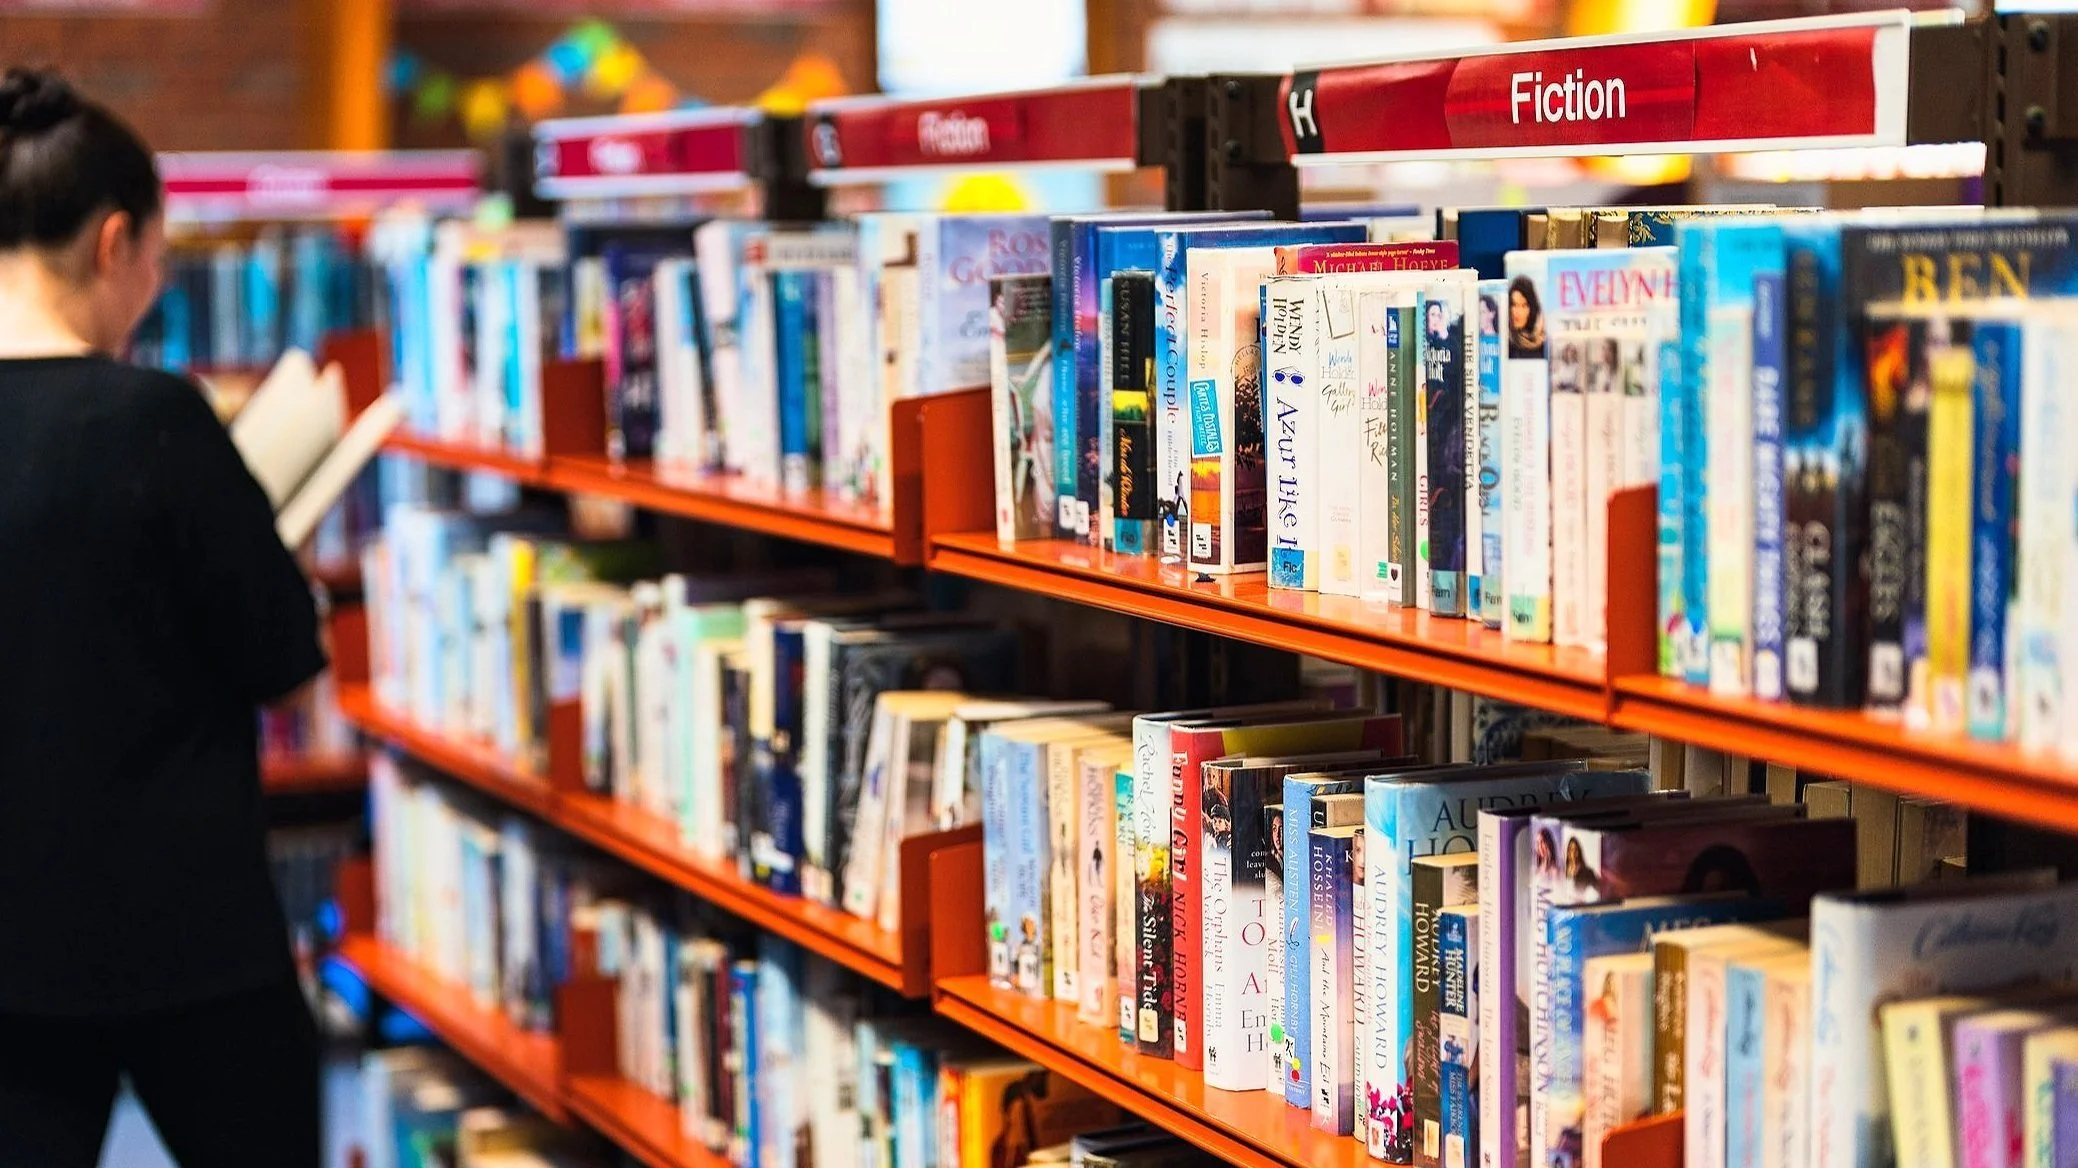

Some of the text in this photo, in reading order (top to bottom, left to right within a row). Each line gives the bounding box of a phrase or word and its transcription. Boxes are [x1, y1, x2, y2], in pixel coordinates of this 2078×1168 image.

[1289, 89, 1318, 138] H
[1510, 68, 1626, 125] Fiction
[949, 257, 1048, 285] GOOD
[989, 228, 1048, 255] ROS
[1393, 257, 1448, 270] HOEYE
[1165, 267, 1178, 344] Perfect
[1560, 269, 1657, 308] EVELYN
[1902, 251, 2032, 304] BEN
[1120, 280, 1130, 381] SUSAN HILL
[1199, 272, 1209, 370] Victoria Hislop
[1273, 297, 1288, 354] HOLDEN
[1289, 298, 1304, 356] WENDY
[1162, 349, 1180, 423] Couple
[1361, 396, 1387, 410] Hold
[1389, 351, 1397, 396] ANNE
[1193, 381, 1220, 452] CARTES POSTALES
[1276, 397, 1298, 469] Azur
[1389, 408, 1397, 481] HOLMAN
[1465, 331, 1474, 490] THE SILK VENDETTA
[1277, 475, 1300, 528] Like
[1419, 475, 1428, 526] GIRLS
[1284, 562, 1297, 573] Fic
[1138, 741, 1156, 845] Rachel Hore
[1172, 750, 1189, 882] Funny Girl
[1246, 860, 1266, 869] leavi
[1289, 808, 1299, 912] MISS AUSTEN
[1313, 845, 1324, 930] HOSSEINI
[1325, 853, 1333, 927] KHALED
[1482, 833, 1493, 891] Lindsey
[1204, 867, 1214, 959] of Ardwick
[1212, 857, 1228, 973] The Orphans
[1537, 885, 1553, 934] MEG
[1142, 893, 1158, 1010] The Silent Tide
[1174, 890, 1188, 1021] NICK HORNB
[1267, 937, 1279, 974] Moll
[1354, 914, 1365, 1025] HOWARD
[1375, 865, 1387, 1070] AUDREY HOWARD
[1415, 902, 1430, 993] HOWARD
[1431, 908, 1441, 988] AUDREY
[1445, 948, 1457, 1008] HUNTER
[1455, 947, 1465, 1014] MADELINE
[1215, 983, 1225, 1028] Emma
[1271, 998, 1279, 1022] Hor
[1289, 955, 1299, 1034] GILL HORNBY
[1320, 948, 1330, 1059] And the Mountains
[1535, 942, 1552, 1096] HUTCHINSON
[1449, 1071, 1457, 1094] MISS
[1604, 1075, 1620, 1131] HUTC
